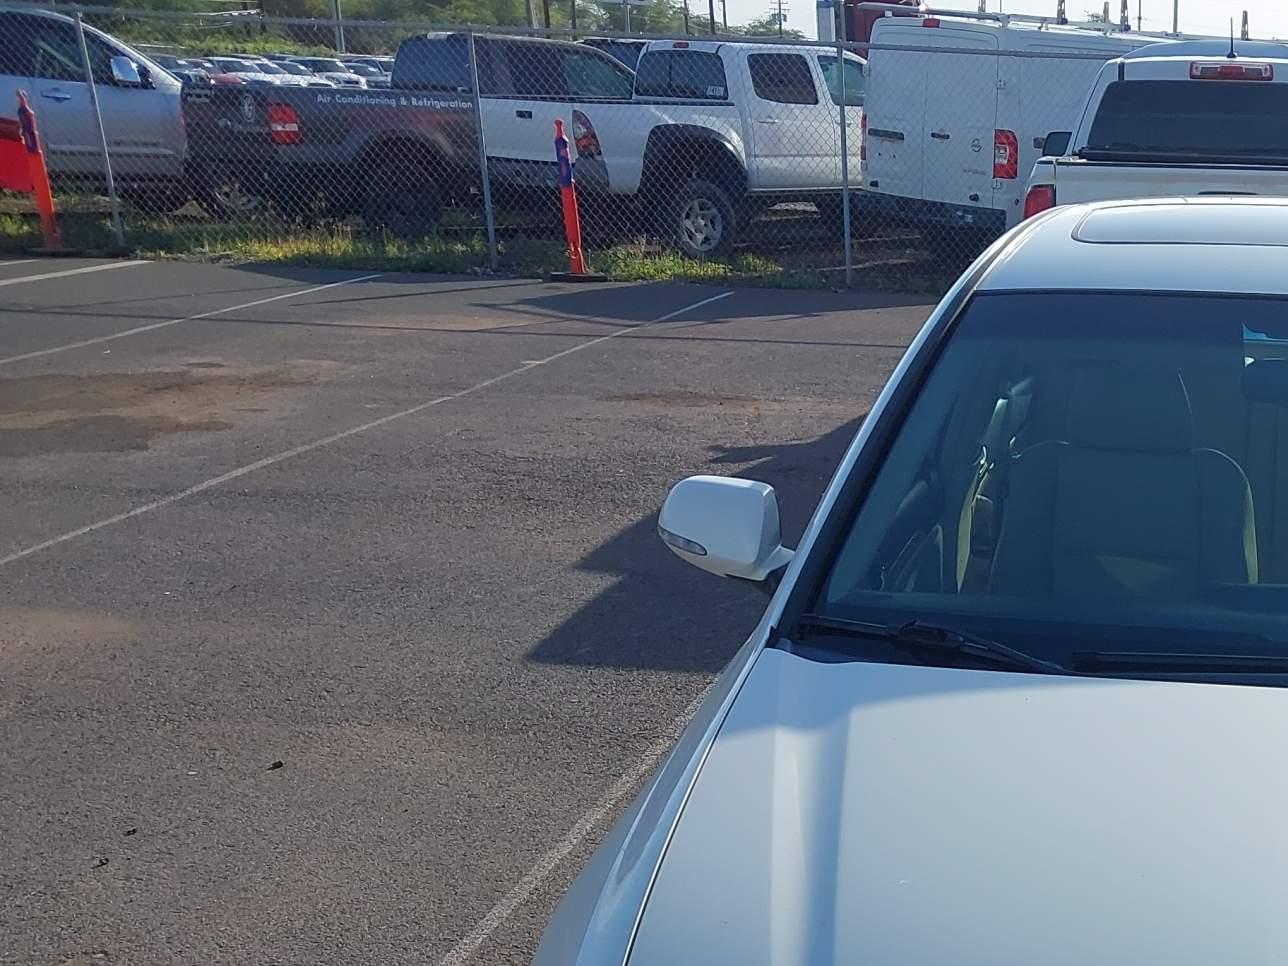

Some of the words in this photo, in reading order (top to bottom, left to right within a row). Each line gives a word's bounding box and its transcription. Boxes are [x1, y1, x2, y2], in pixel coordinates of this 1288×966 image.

[316, 93, 331, 103] Air
[335, 94, 396, 107] Conditioning
[401, 96, 407, 105] &
[411, 96, 473, 109] Refrigeration
